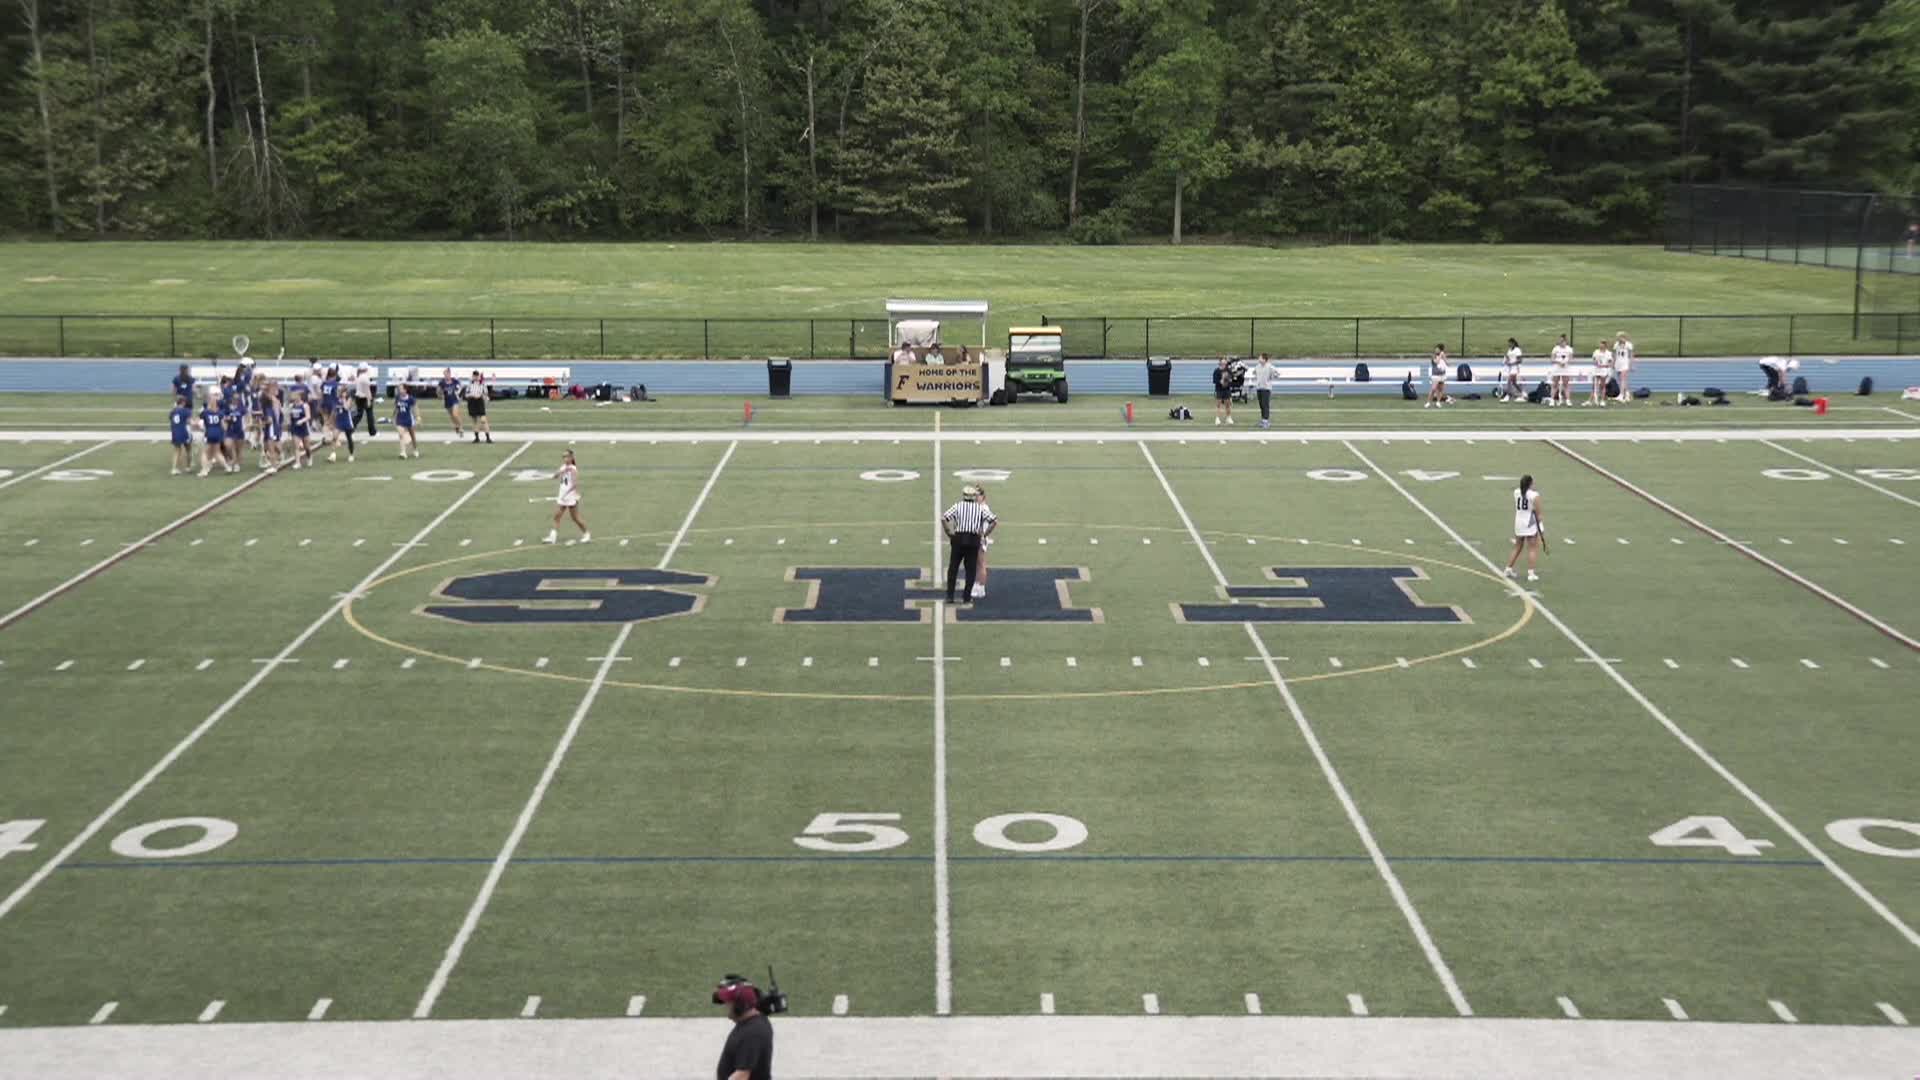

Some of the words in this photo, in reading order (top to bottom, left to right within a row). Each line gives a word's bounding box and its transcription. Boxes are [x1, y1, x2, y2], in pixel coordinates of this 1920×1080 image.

[918, 368, 944, 377] HOME
[946, 368, 958, 377] OF
[960, 368, 977, 377] THE
[896, 375, 910, 391] F
[916, 381, 981, 391] WARRIORS
[1516, 496, 1529, 510] 18
